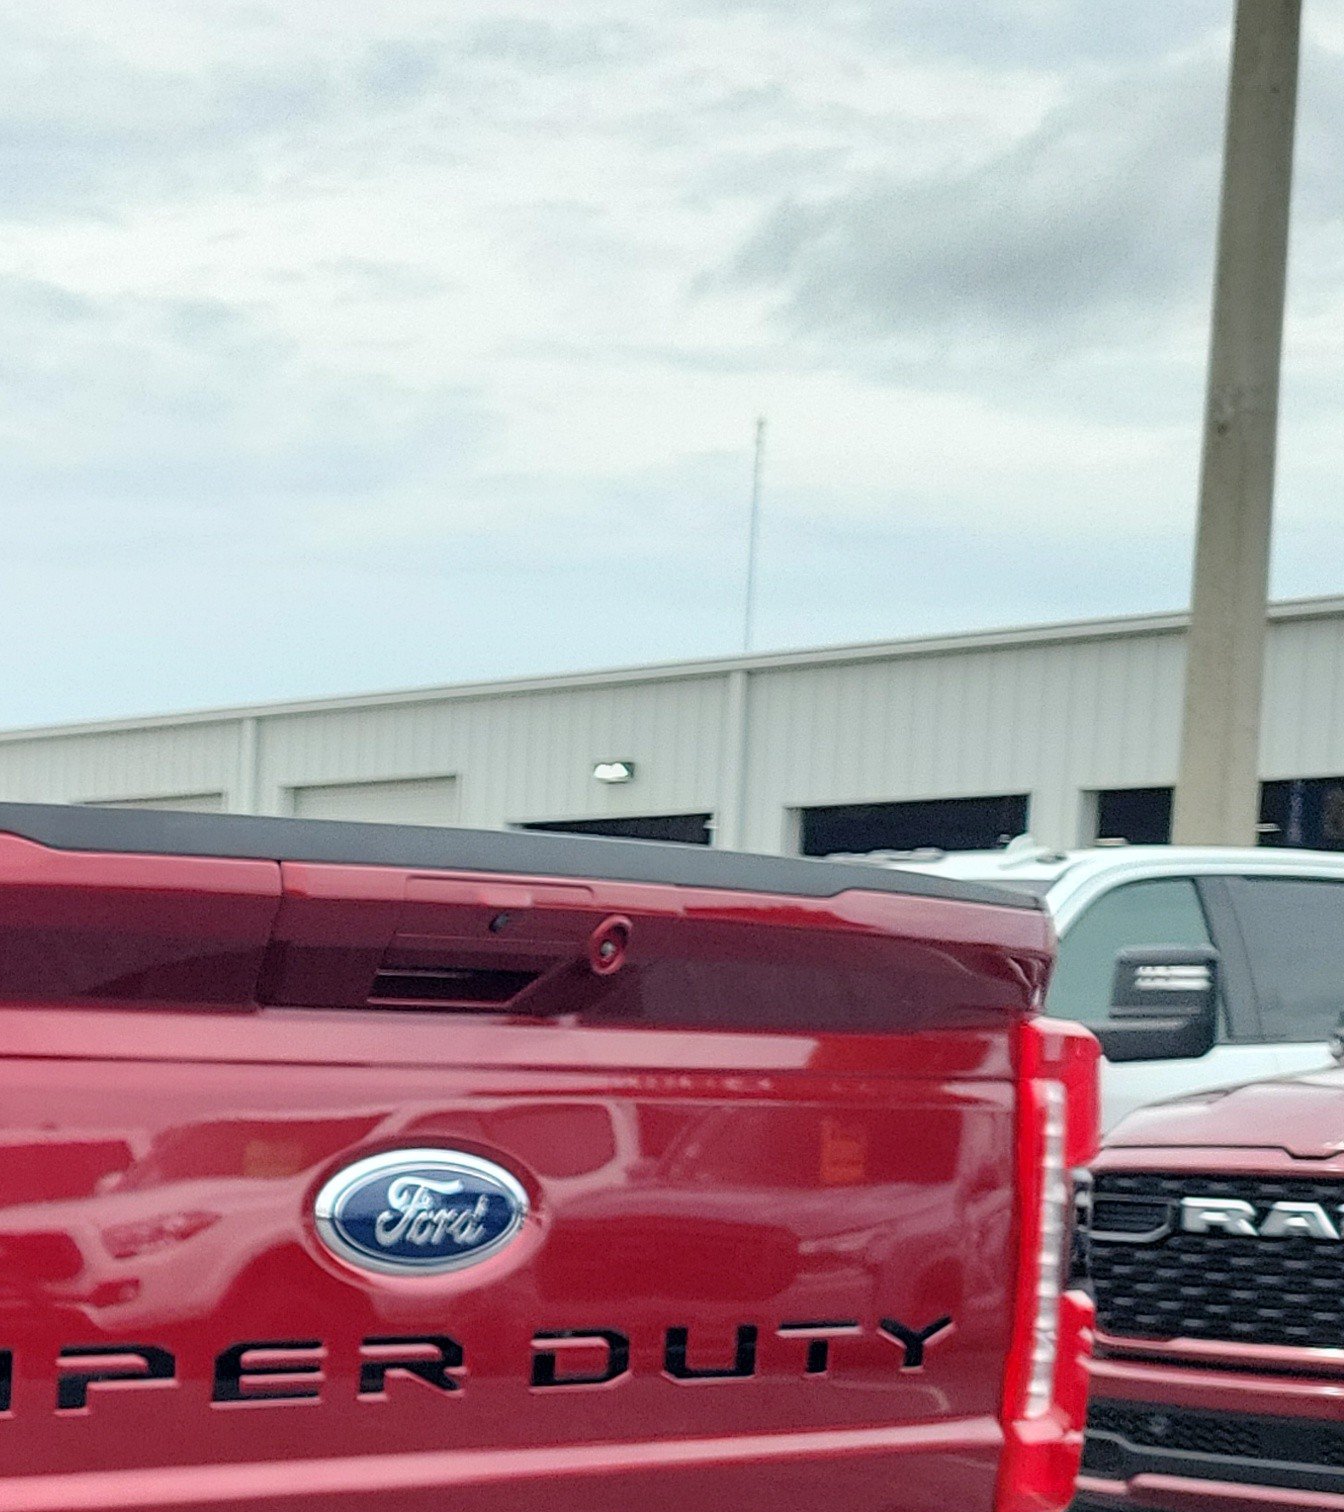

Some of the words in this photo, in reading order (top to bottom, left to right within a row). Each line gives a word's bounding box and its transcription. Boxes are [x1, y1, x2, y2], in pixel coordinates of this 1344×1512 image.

[374, 1175, 490, 1247] Ford
[1180, 1196, 1344, 1241] RA
[530, 1315, 956, 1393] DUTY
